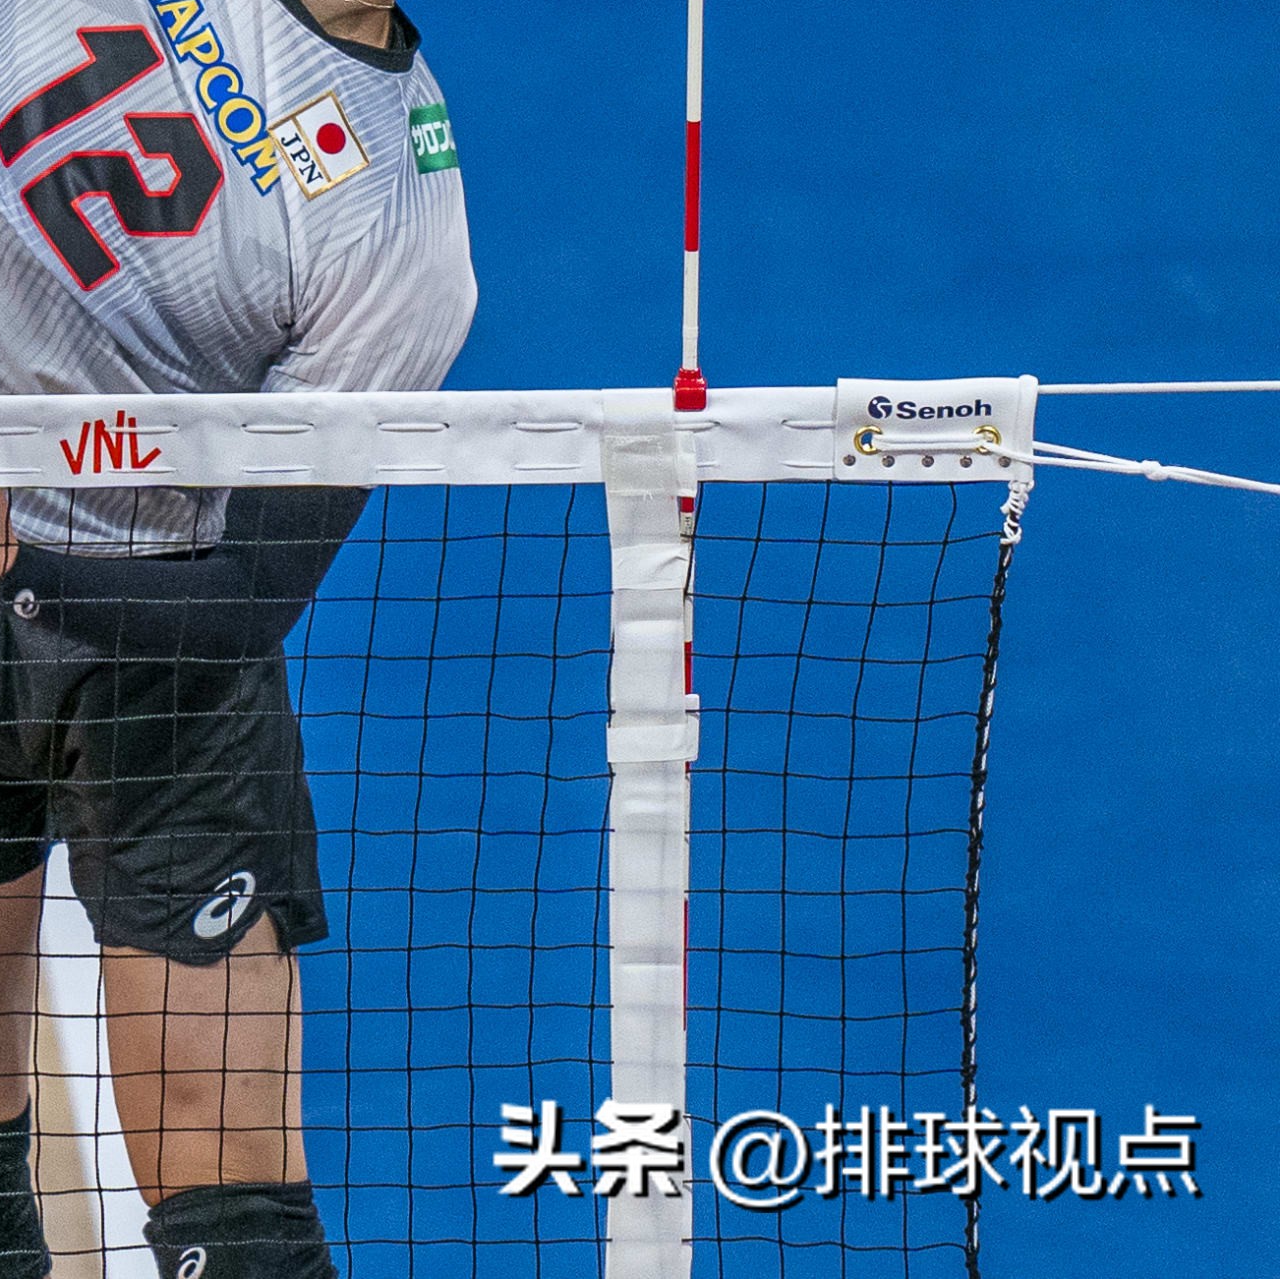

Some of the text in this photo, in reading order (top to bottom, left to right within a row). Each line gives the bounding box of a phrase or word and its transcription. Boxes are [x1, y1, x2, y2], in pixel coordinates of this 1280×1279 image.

[280, 132, 324, 184] JPN
[896, 399, 992, 420] Senoh
[59, 409, 162, 475] VNL
